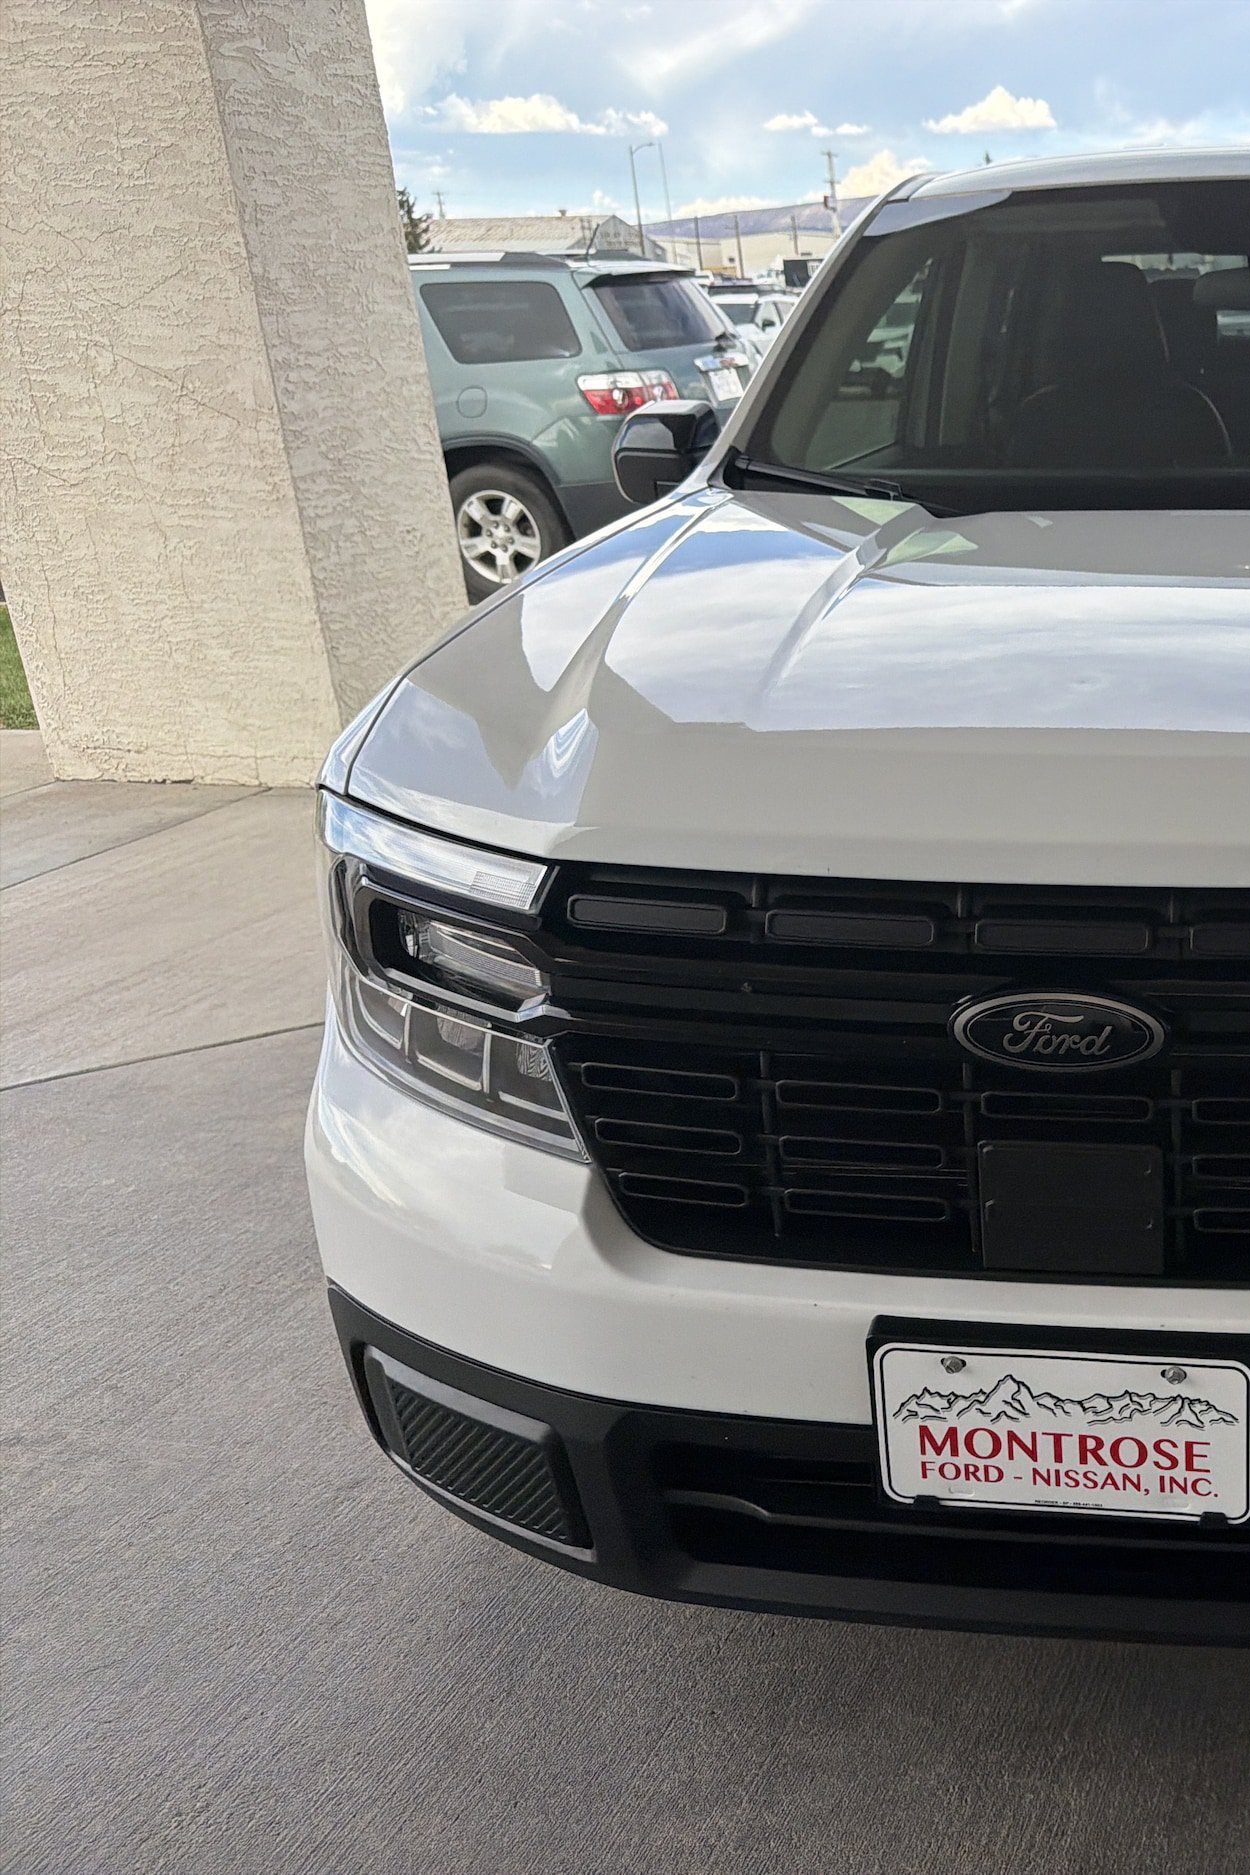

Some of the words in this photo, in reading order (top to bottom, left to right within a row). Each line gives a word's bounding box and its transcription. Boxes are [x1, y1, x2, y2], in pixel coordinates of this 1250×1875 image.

[1002, 1011, 1112, 1055] Ford
[918, 1425, 1211, 1473] MONTROSE
[920, 1461, 1004, 1483] FORD
[1032, 1467, 1150, 1496] NISSAN,
[1159, 1475, 1219, 1498] INC.
